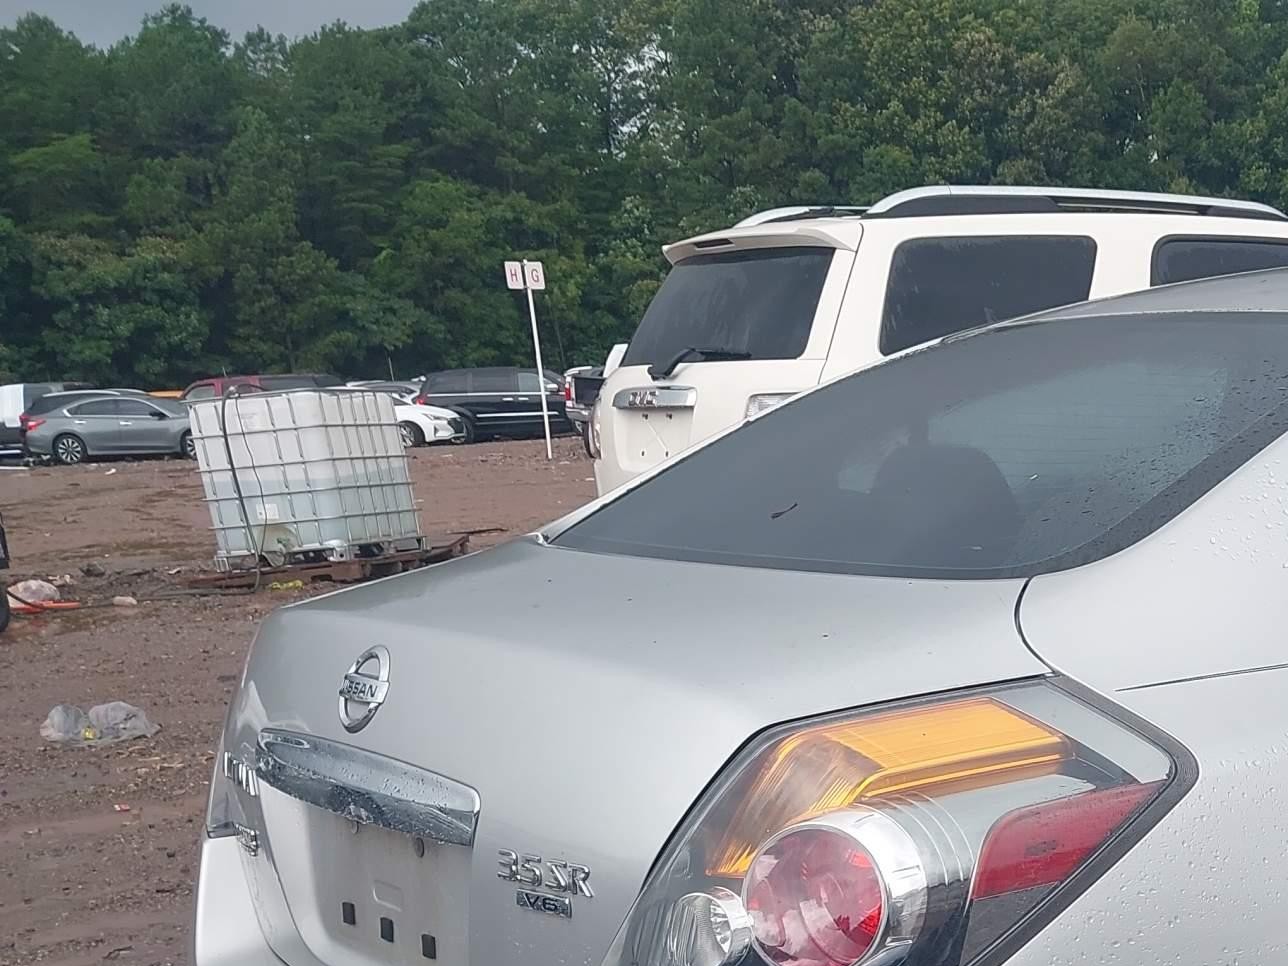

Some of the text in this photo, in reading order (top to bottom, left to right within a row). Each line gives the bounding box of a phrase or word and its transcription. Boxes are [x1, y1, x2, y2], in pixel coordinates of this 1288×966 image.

[510, 267, 519, 282] H
[530, 268, 540, 283] G
[523, 892, 563, 914] V6
